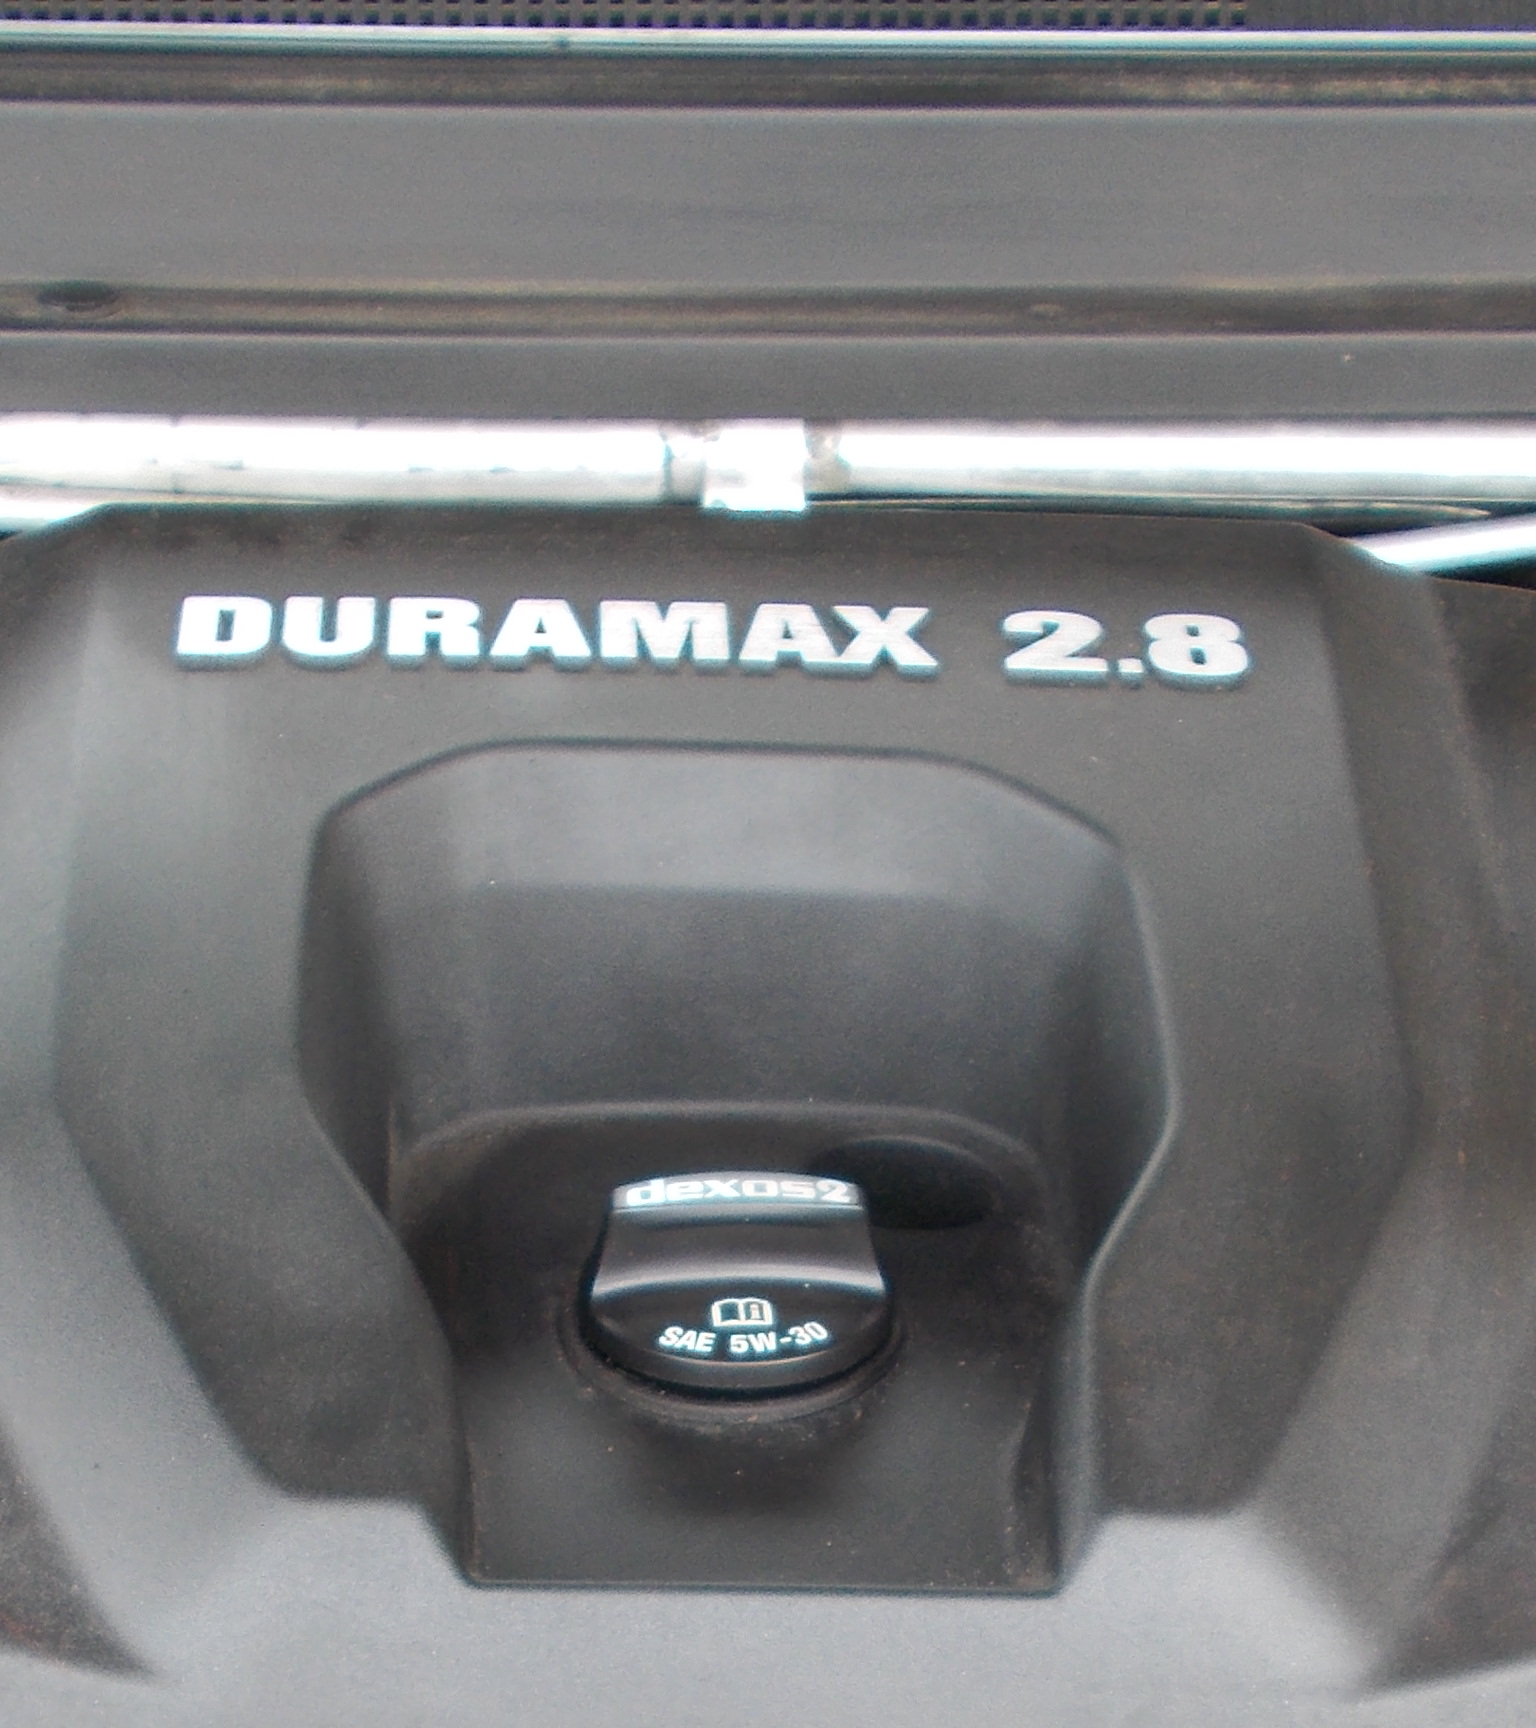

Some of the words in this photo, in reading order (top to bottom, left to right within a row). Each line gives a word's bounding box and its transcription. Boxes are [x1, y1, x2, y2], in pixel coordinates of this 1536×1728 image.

[175, 595, 940, 671] DURAMAX
[1001, 610, 1250, 680] 2.8
[625, 1178, 851, 1207] dexos2
[658, 1324, 717, 1353] SAE
[729, 1320, 830, 1353] 5W-30
